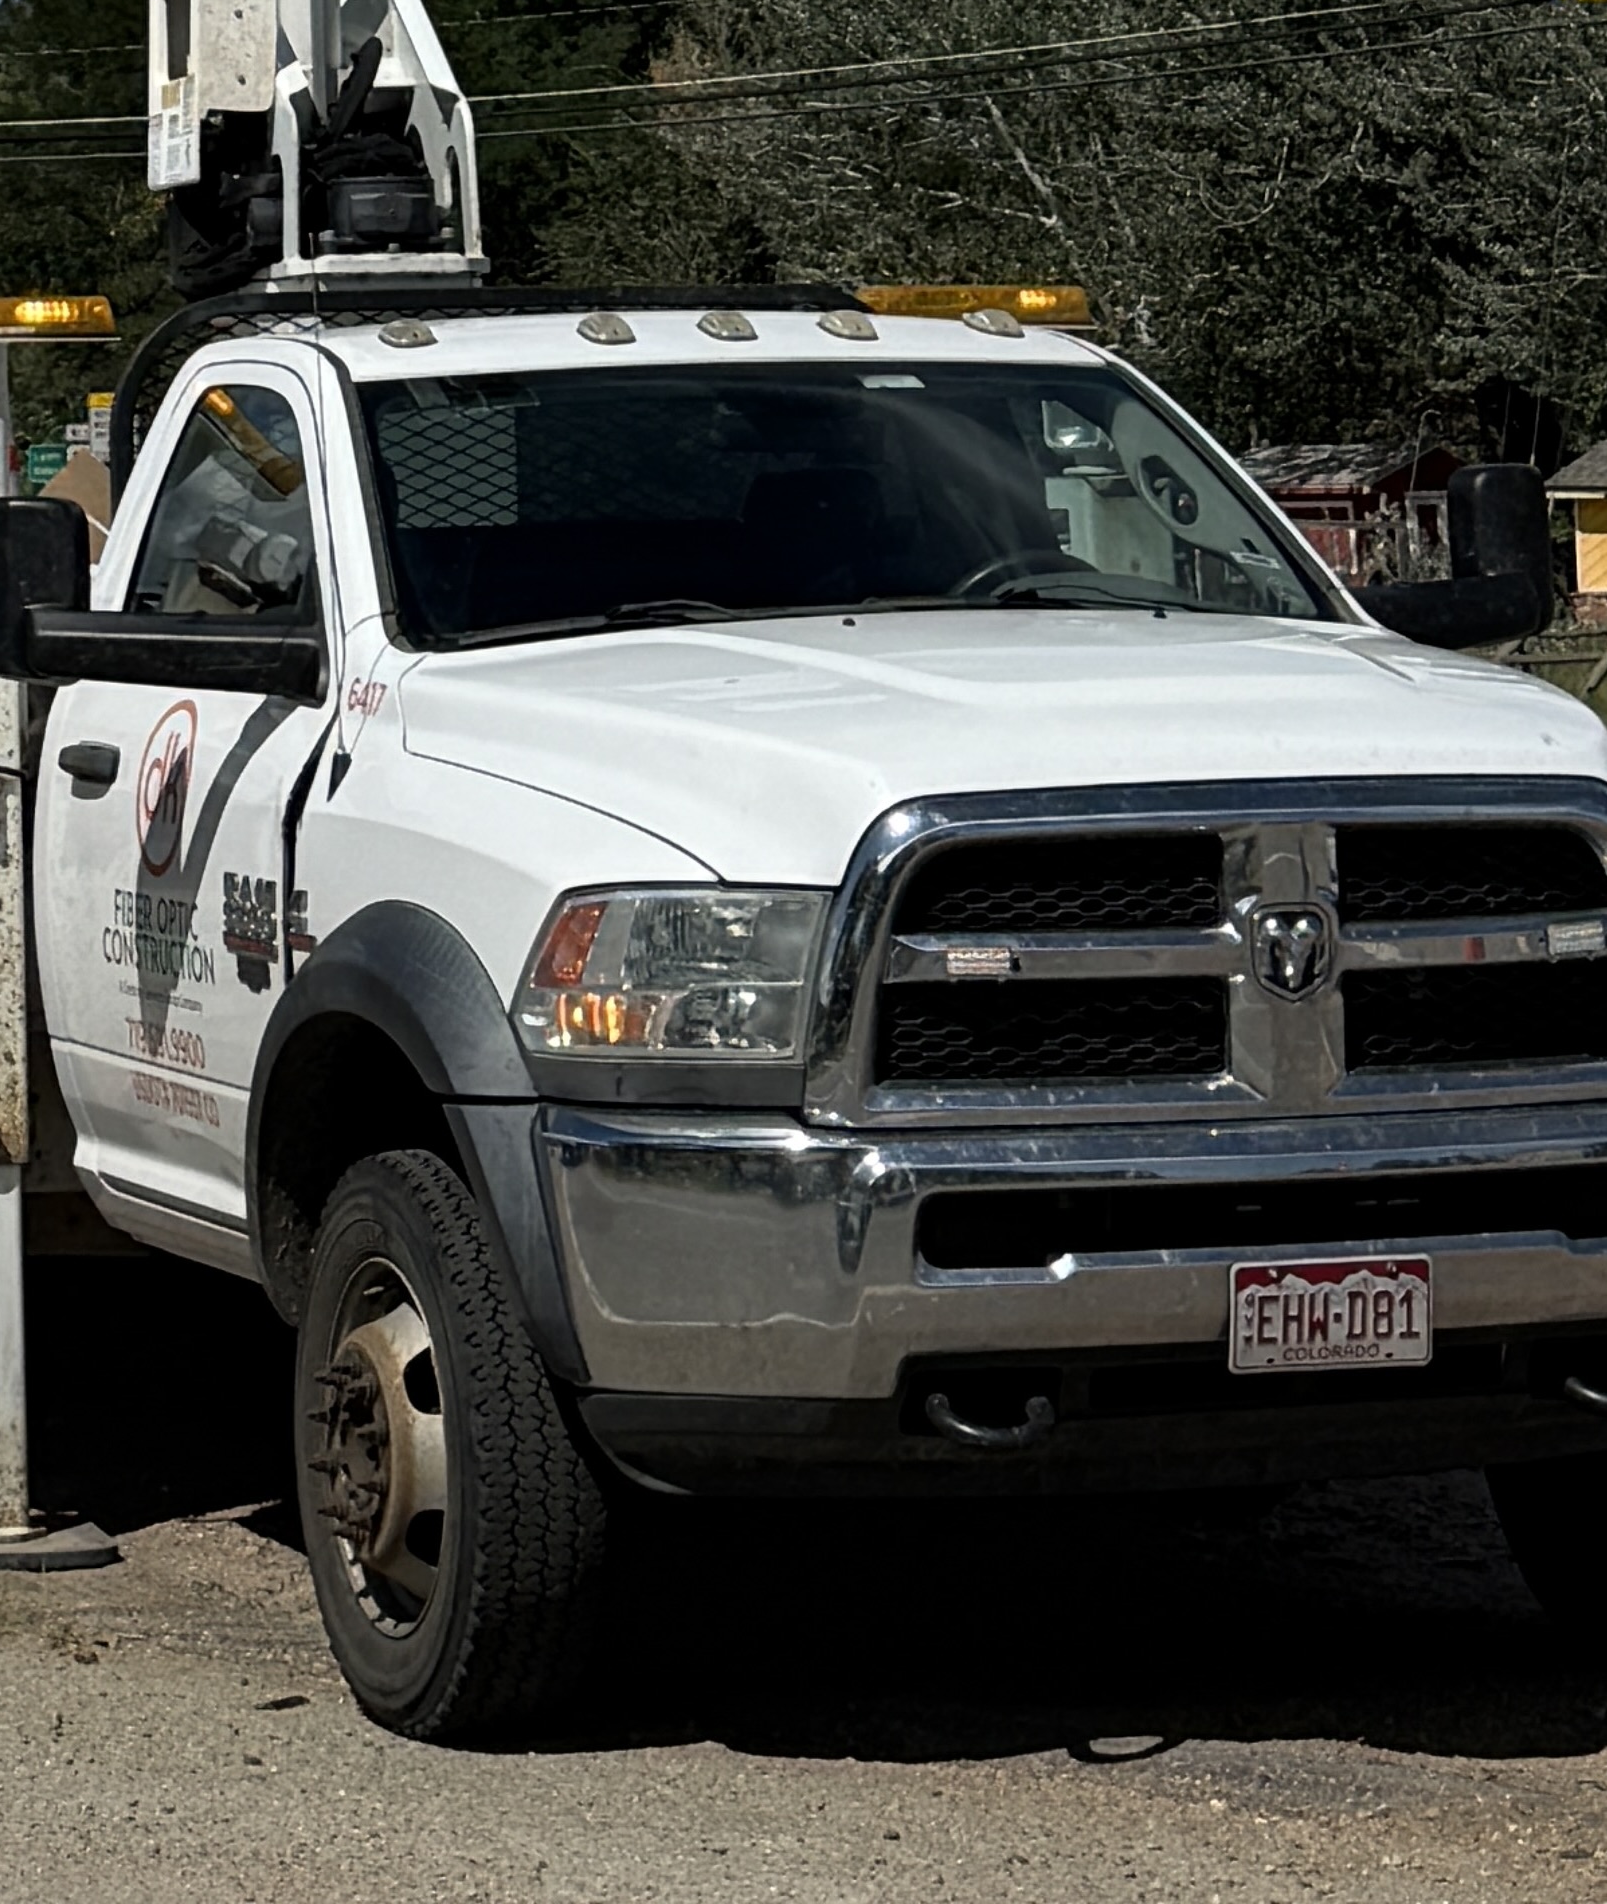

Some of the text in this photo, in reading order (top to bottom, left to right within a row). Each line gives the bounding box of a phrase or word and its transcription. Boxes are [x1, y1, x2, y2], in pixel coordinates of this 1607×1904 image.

[347, 676, 388, 717] 6417
[114, 888, 198, 942] FIBER OPTIC
[102, 927, 215, 985] CONSTRUCTION
[1282, 1343, 1381, 1362] COLORADO
